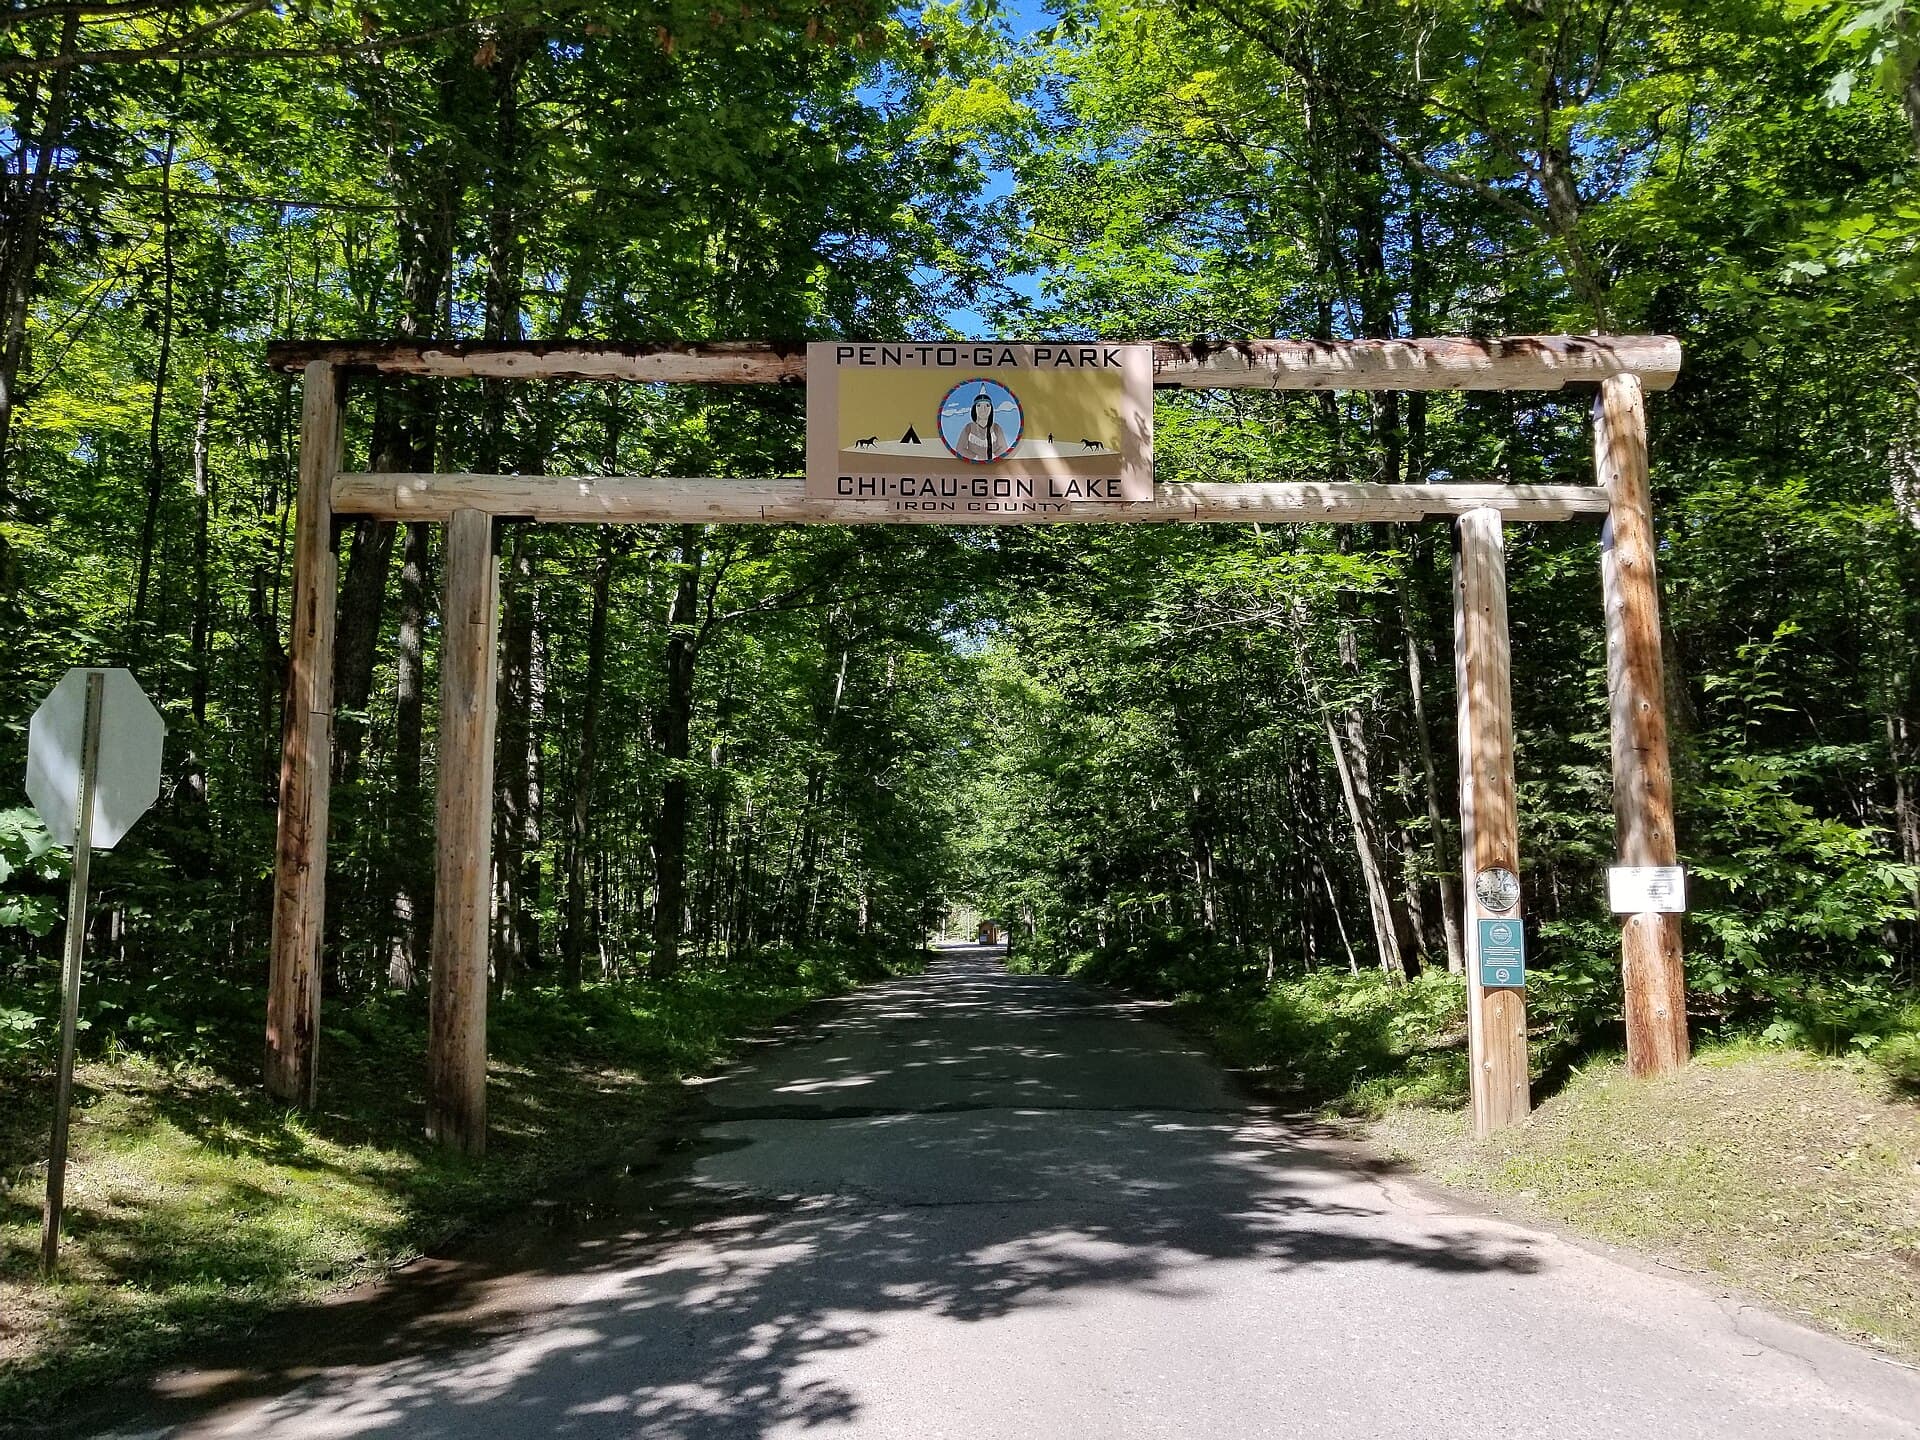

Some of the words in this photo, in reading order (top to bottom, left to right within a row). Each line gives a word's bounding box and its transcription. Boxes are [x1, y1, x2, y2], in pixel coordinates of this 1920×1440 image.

[836, 346, 1018, 368] PEN-TO-GA
[1034, 348, 1123, 368] PARK
[837, 476, 1034, 498] CHI-CAU-GON
[1049, 478, 1122, 498] LAKE
[896, 501, 954, 512] IRON
[967, 502, 1068, 512] COUNTY
